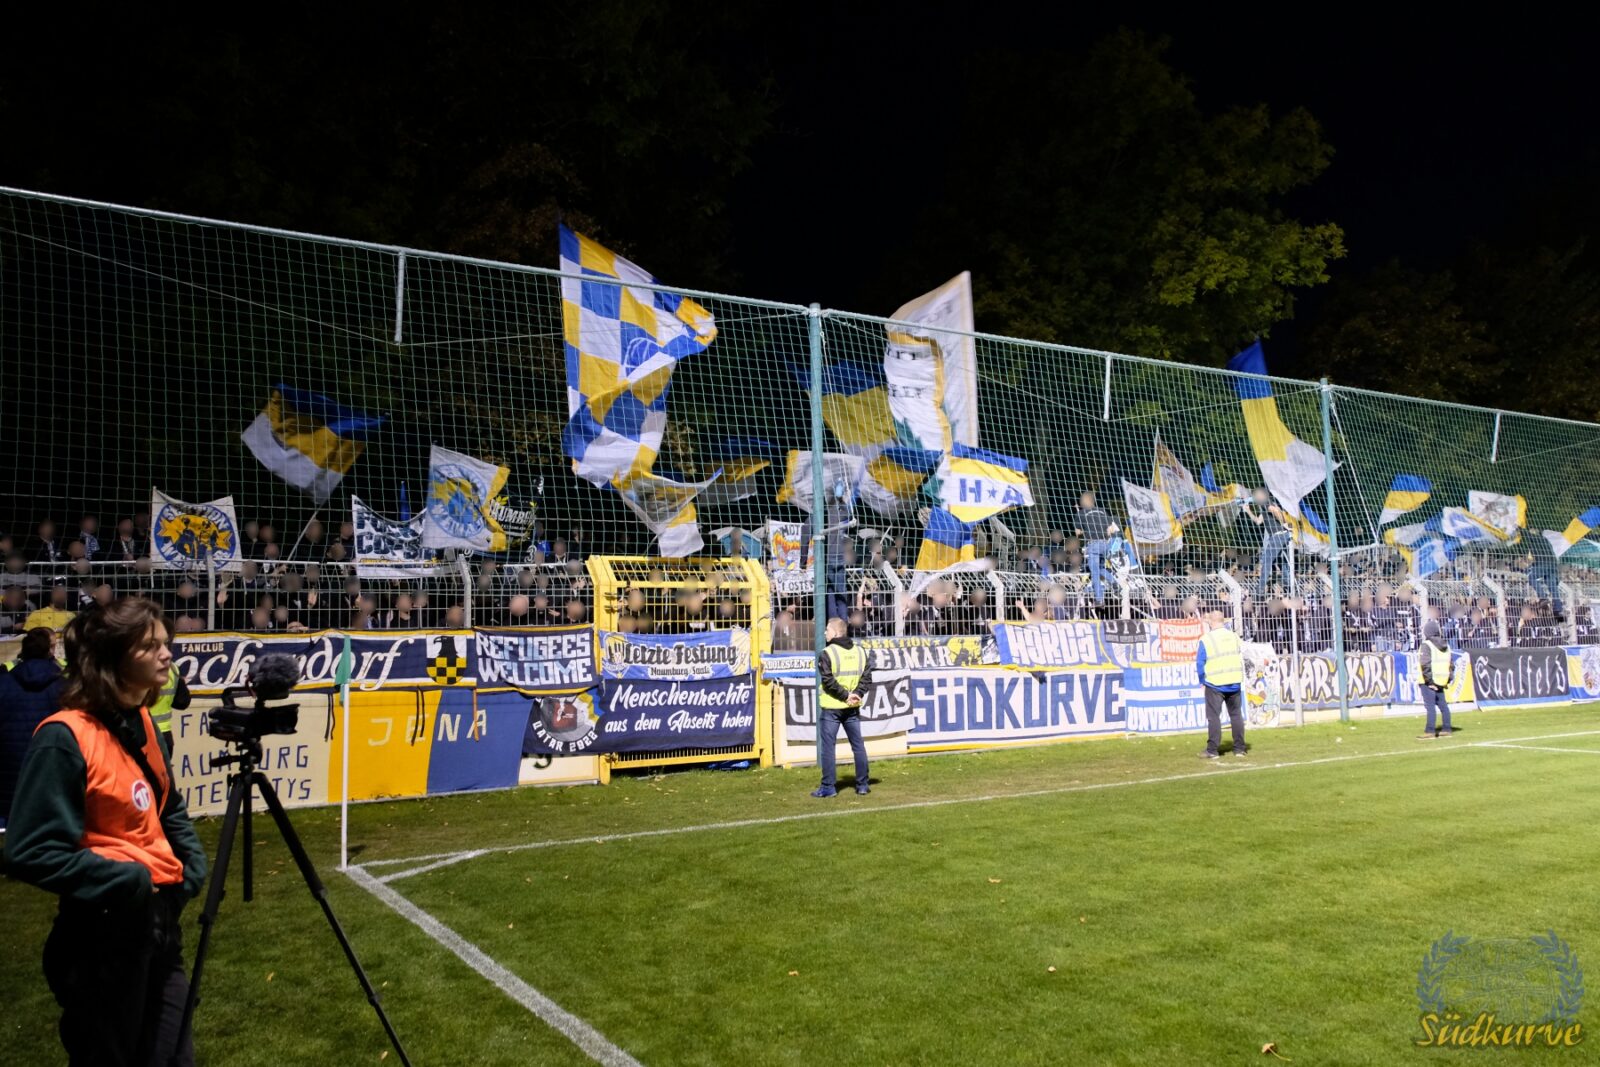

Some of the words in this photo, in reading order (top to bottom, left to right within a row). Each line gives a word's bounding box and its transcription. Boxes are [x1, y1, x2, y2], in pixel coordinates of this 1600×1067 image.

[181, 642, 224, 653] FANCLUB
[475, 630, 591, 660] REFUGEES
[866, 645, 955, 670] EIMAR
[477, 657, 593, 686] WELCOME
[1141, 664, 1200, 688] UNBEUG
[609, 682, 753, 712] Menschenrechte
[909, 672, 1126, 733] SÜDKURVE
[367, 709, 488, 747] JENA
[604, 718, 628, 733] aus
[634, 712, 661, 731] dem
[667, 709, 719, 733] Abseits
[721, 710, 753, 728] holen
[1127, 700, 1208, 732] UNVERKÄU
[532, 720, 564, 752] QATAR
[568, 730, 599, 752] 2022
